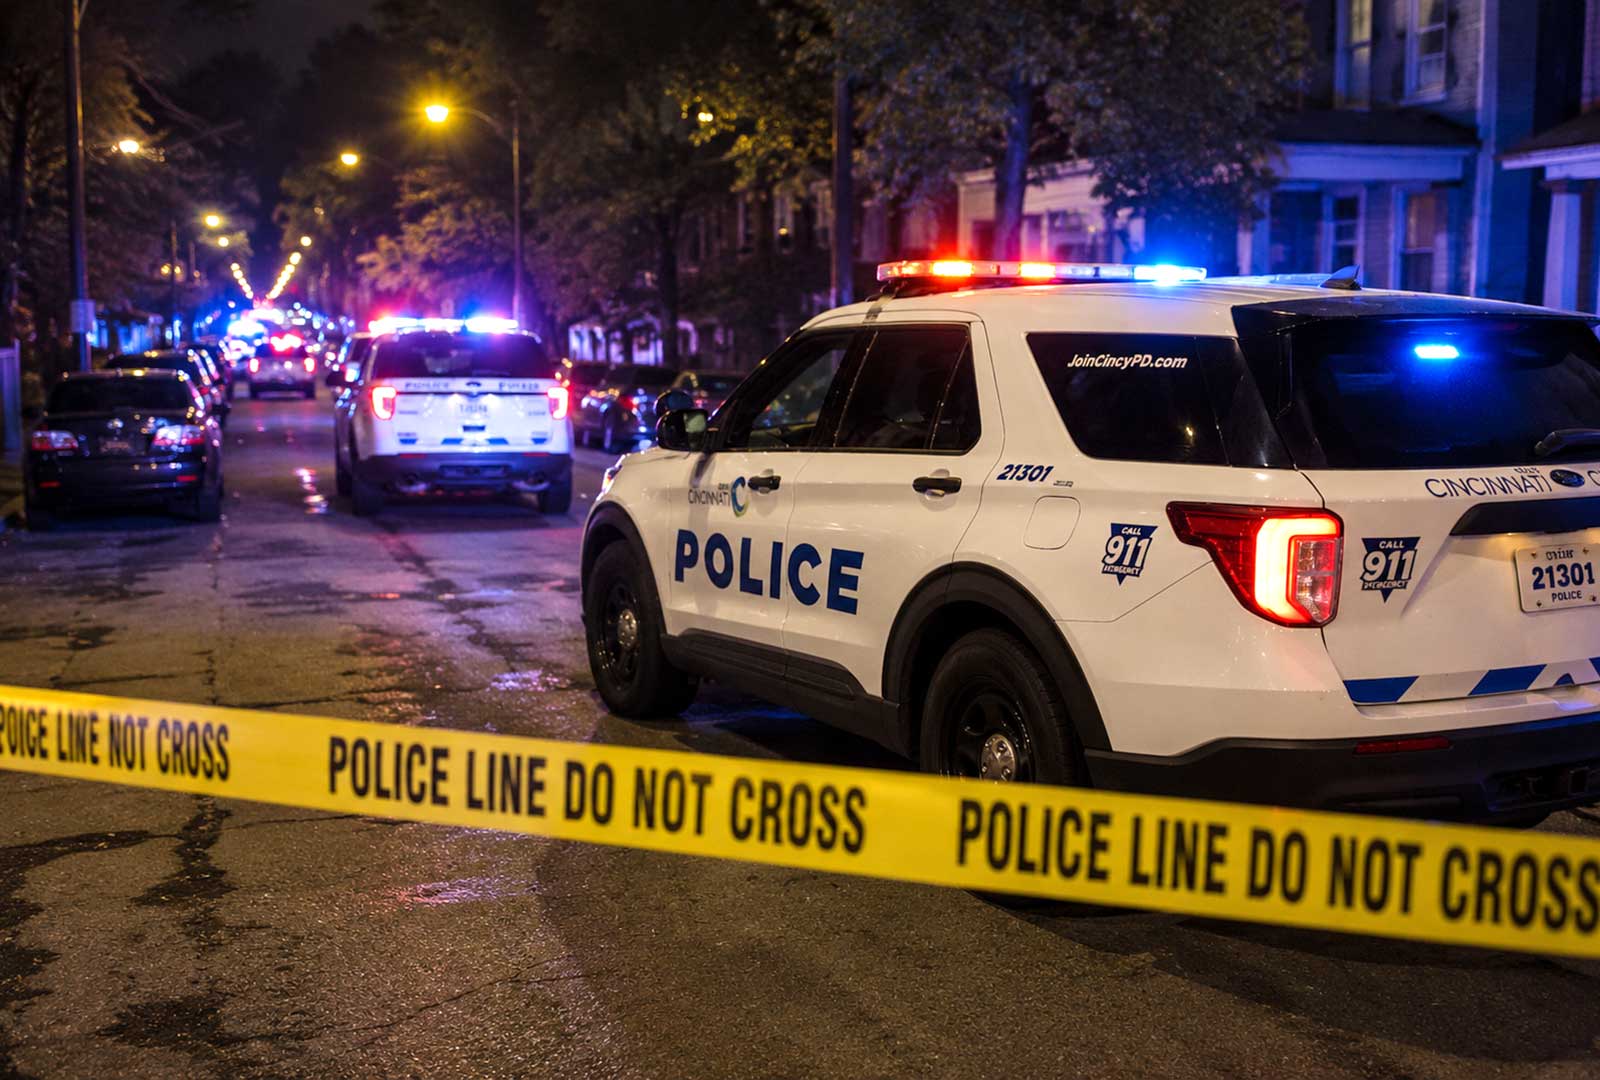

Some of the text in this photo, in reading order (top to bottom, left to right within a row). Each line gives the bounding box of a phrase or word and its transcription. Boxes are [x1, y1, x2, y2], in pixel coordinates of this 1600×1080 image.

[1067, 353, 1188, 370] JoinCincyPD.com
[997, 464, 1054, 482] 21301
[1425, 475, 1553, 498] CINCINNATI
[1121, 526, 1141, 535] CALL
[1378, 540, 1405, 549] CALL
[1104, 535, 1151, 568] 911
[1362, 550, 1415, 581] 911
[674, 529, 864, 616] POLICE
[1531, 562, 1595, 590] 21301
[1551, 590, 1583, 603] POLICE
[109, 713, 148, 772] NOT
[156, 718, 230, 782] CROSS
[329, 736, 867, 855] POLICE LINE DO NOT CROSS
[957, 798, 1600, 935] POLICE LINE DO NOT CROSS
